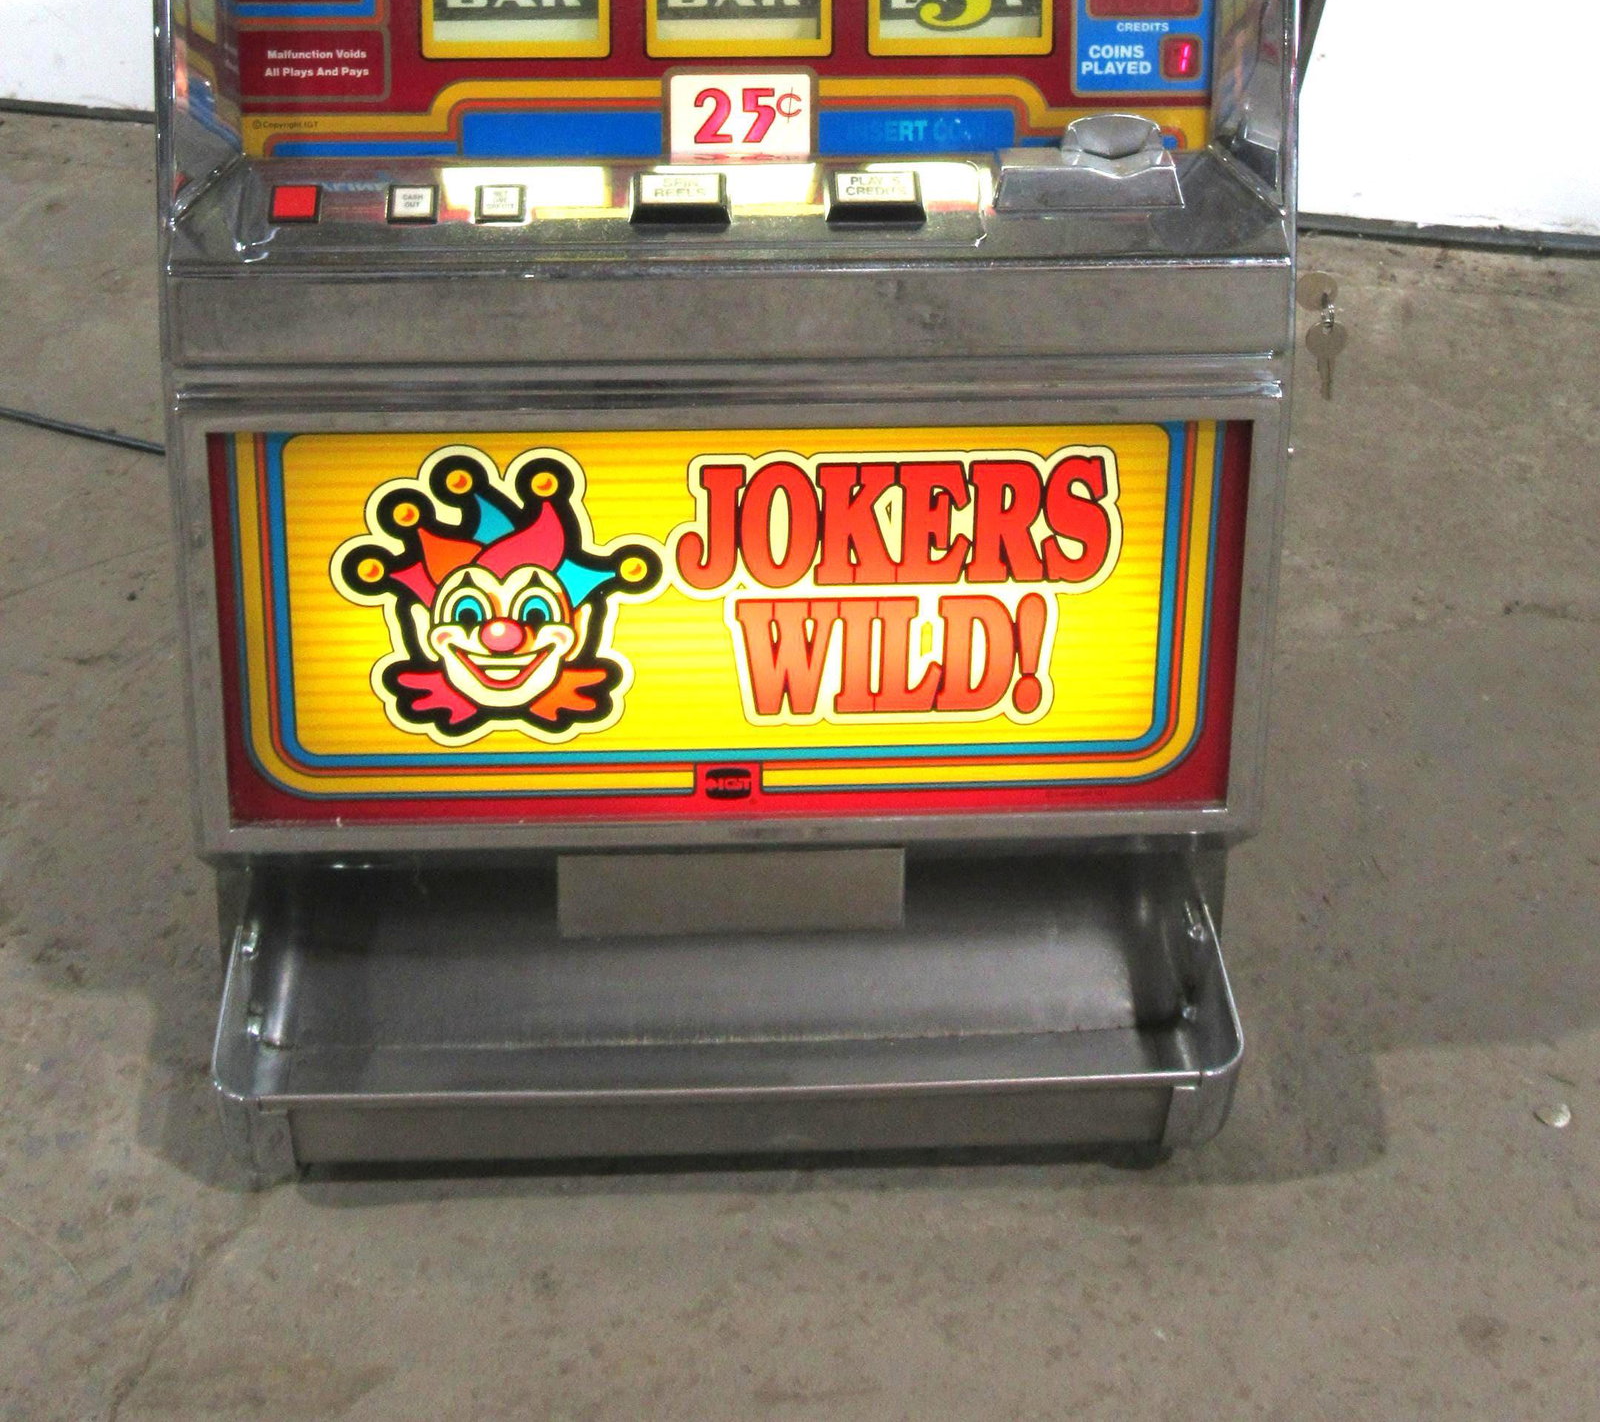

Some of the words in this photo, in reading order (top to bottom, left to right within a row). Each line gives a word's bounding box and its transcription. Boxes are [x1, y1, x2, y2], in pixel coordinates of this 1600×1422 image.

[1116, 22, 1169, 32] CREDITS
[267, 49, 333, 59] Malfunction
[335, 49, 367, 59] Voids
[1088, 44, 1144, 59] COINS
[1180, 43, 1190, 73] 1
[265, 67, 280, 77] All
[282, 67, 314, 78] Plays
[316, 67, 338, 77] And
[341, 67, 369, 78] Pays
[1081, 61, 1152, 75] PLAYED
[694, 87, 802, 143] 25¢
[850, 176, 884, 186] PLAY
[846, 186, 906, 196] CREDI
[675, 454, 1111, 589] JOKERS
[735, 592, 1049, 716] WILD!
